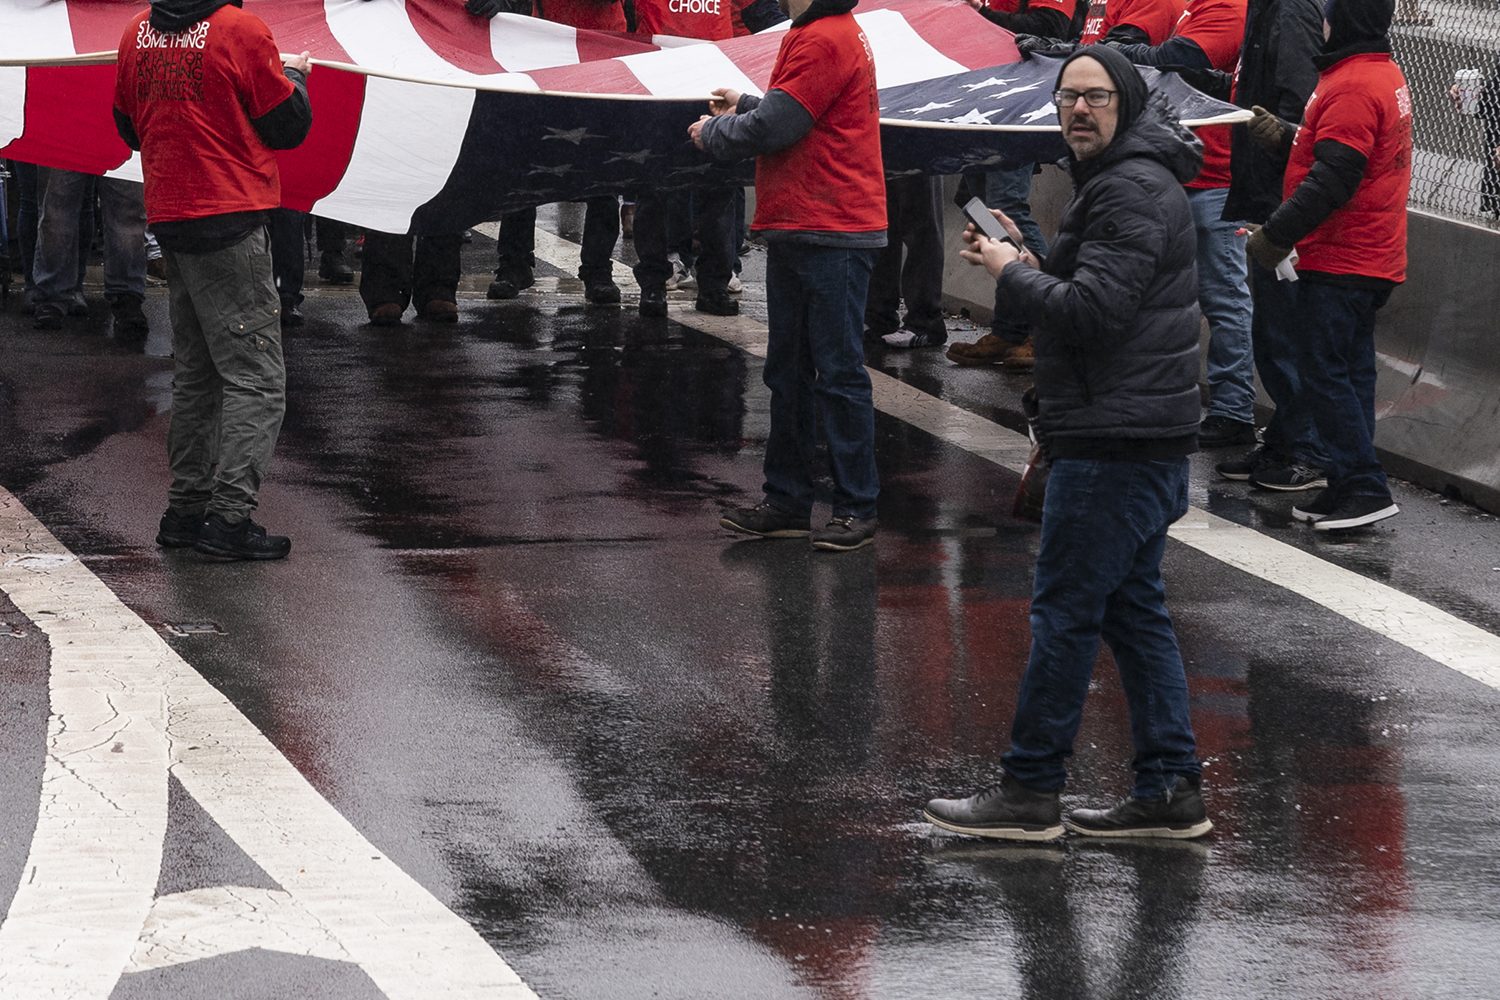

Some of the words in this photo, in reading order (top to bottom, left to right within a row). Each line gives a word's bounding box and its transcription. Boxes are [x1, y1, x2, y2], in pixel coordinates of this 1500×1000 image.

[136, 33, 206, 49] SOMETHING
[136, 51, 151, 66] OR
[153, 50, 176, 64] FALL
[180, 50, 204, 66] FOR
[137, 63, 204, 81] ANYTHING
